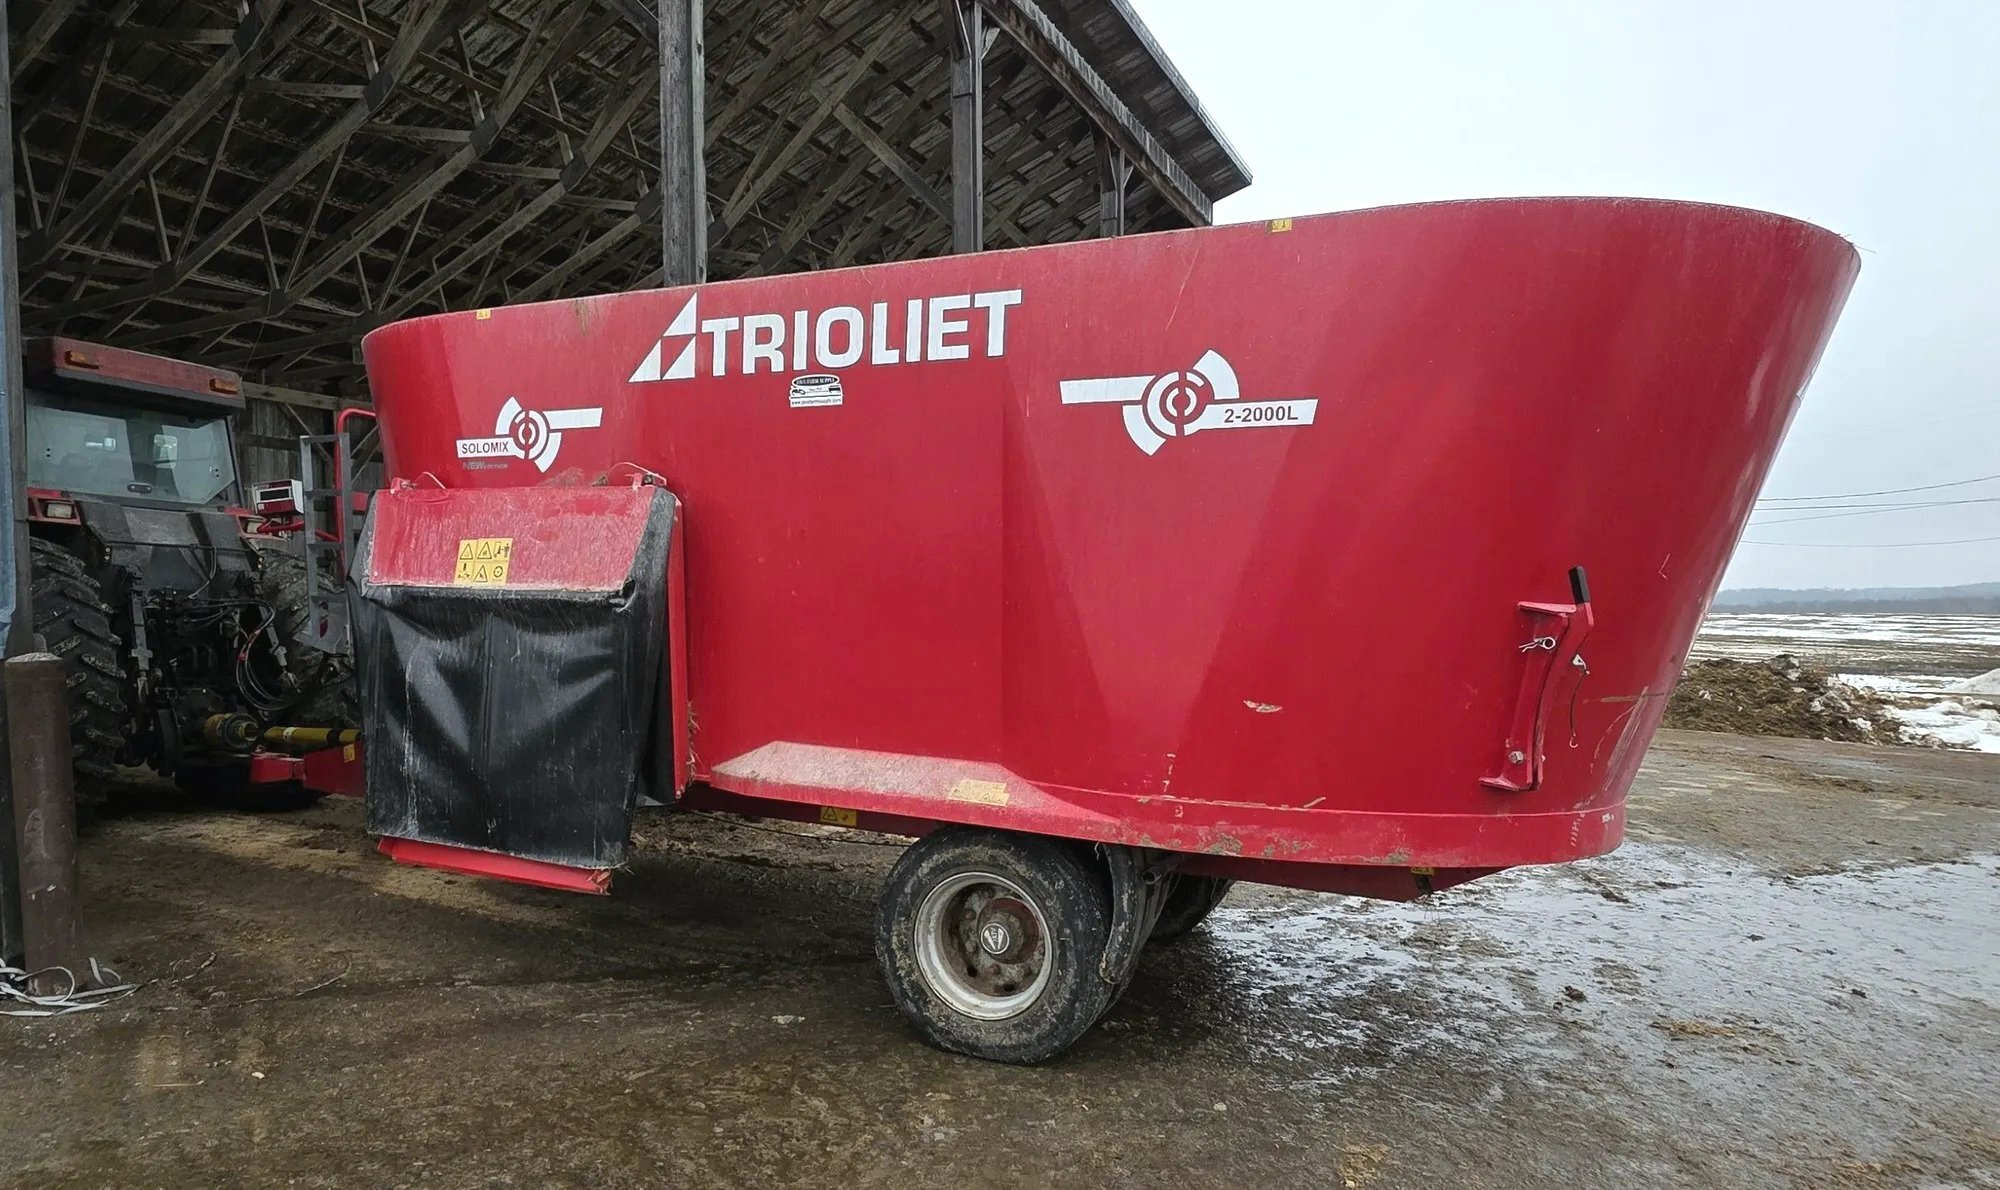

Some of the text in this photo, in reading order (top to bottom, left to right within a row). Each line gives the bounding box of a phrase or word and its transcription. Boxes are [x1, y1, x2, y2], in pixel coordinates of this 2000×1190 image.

[701, 289, 1022, 377] TRIOLIET
[1224, 406, 1298, 423] 2-2000L
[462, 441, 509, 454] SOLOMIX
